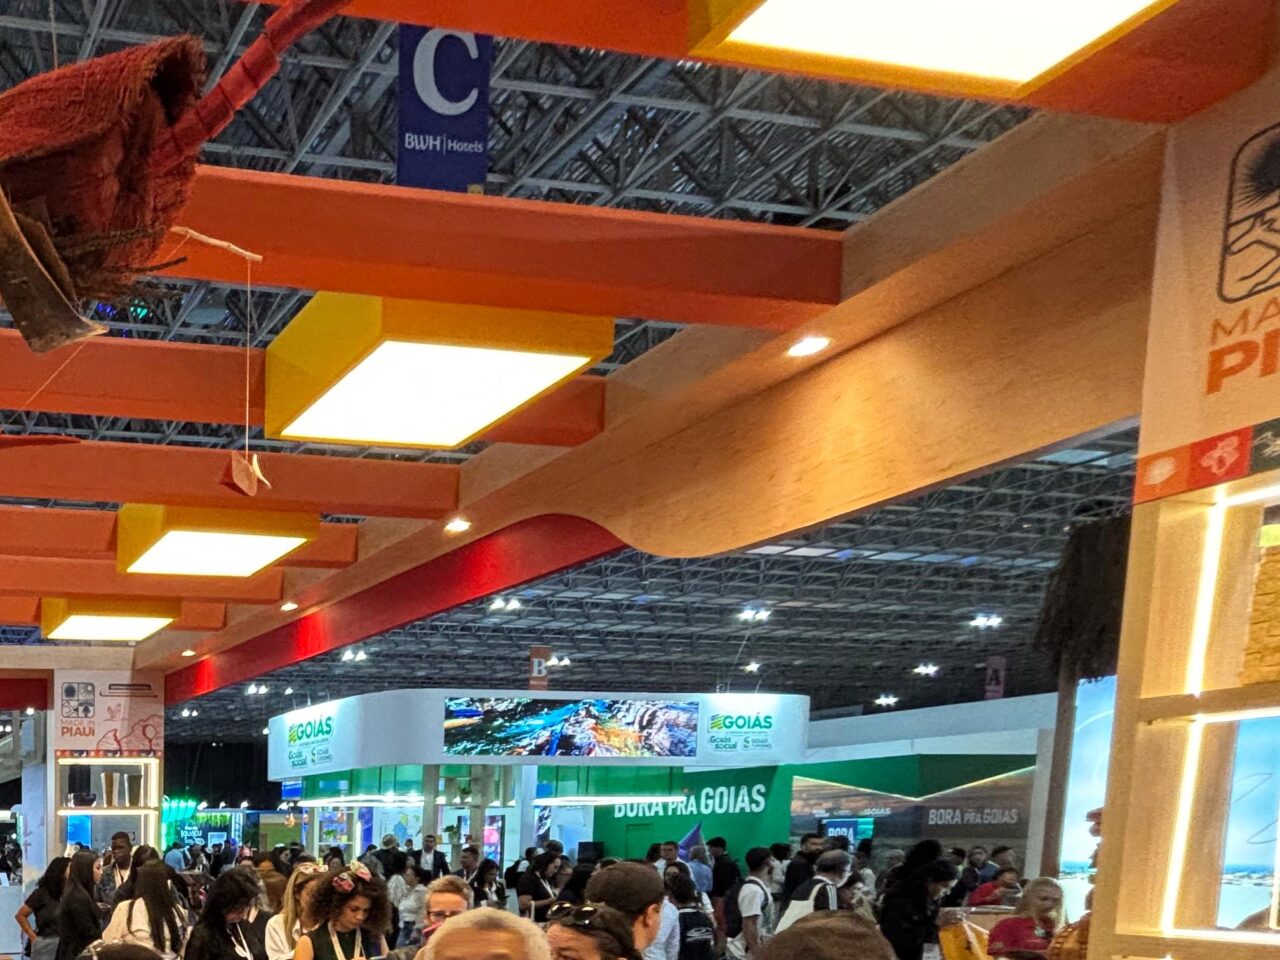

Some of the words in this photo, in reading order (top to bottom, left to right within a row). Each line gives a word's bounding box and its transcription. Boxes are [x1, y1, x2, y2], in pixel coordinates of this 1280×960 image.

[413, 28, 479, 116] C
[405, 133, 441, 150] BWH
[448, 141, 484, 153] Hotels
[532, 658, 547, 677] B
[297, 715, 333, 741] GOIÁS
[722, 712, 774, 730] GOIÁS
[668, 797, 698, 816] PRA
[928, 808, 962, 825] BORA
